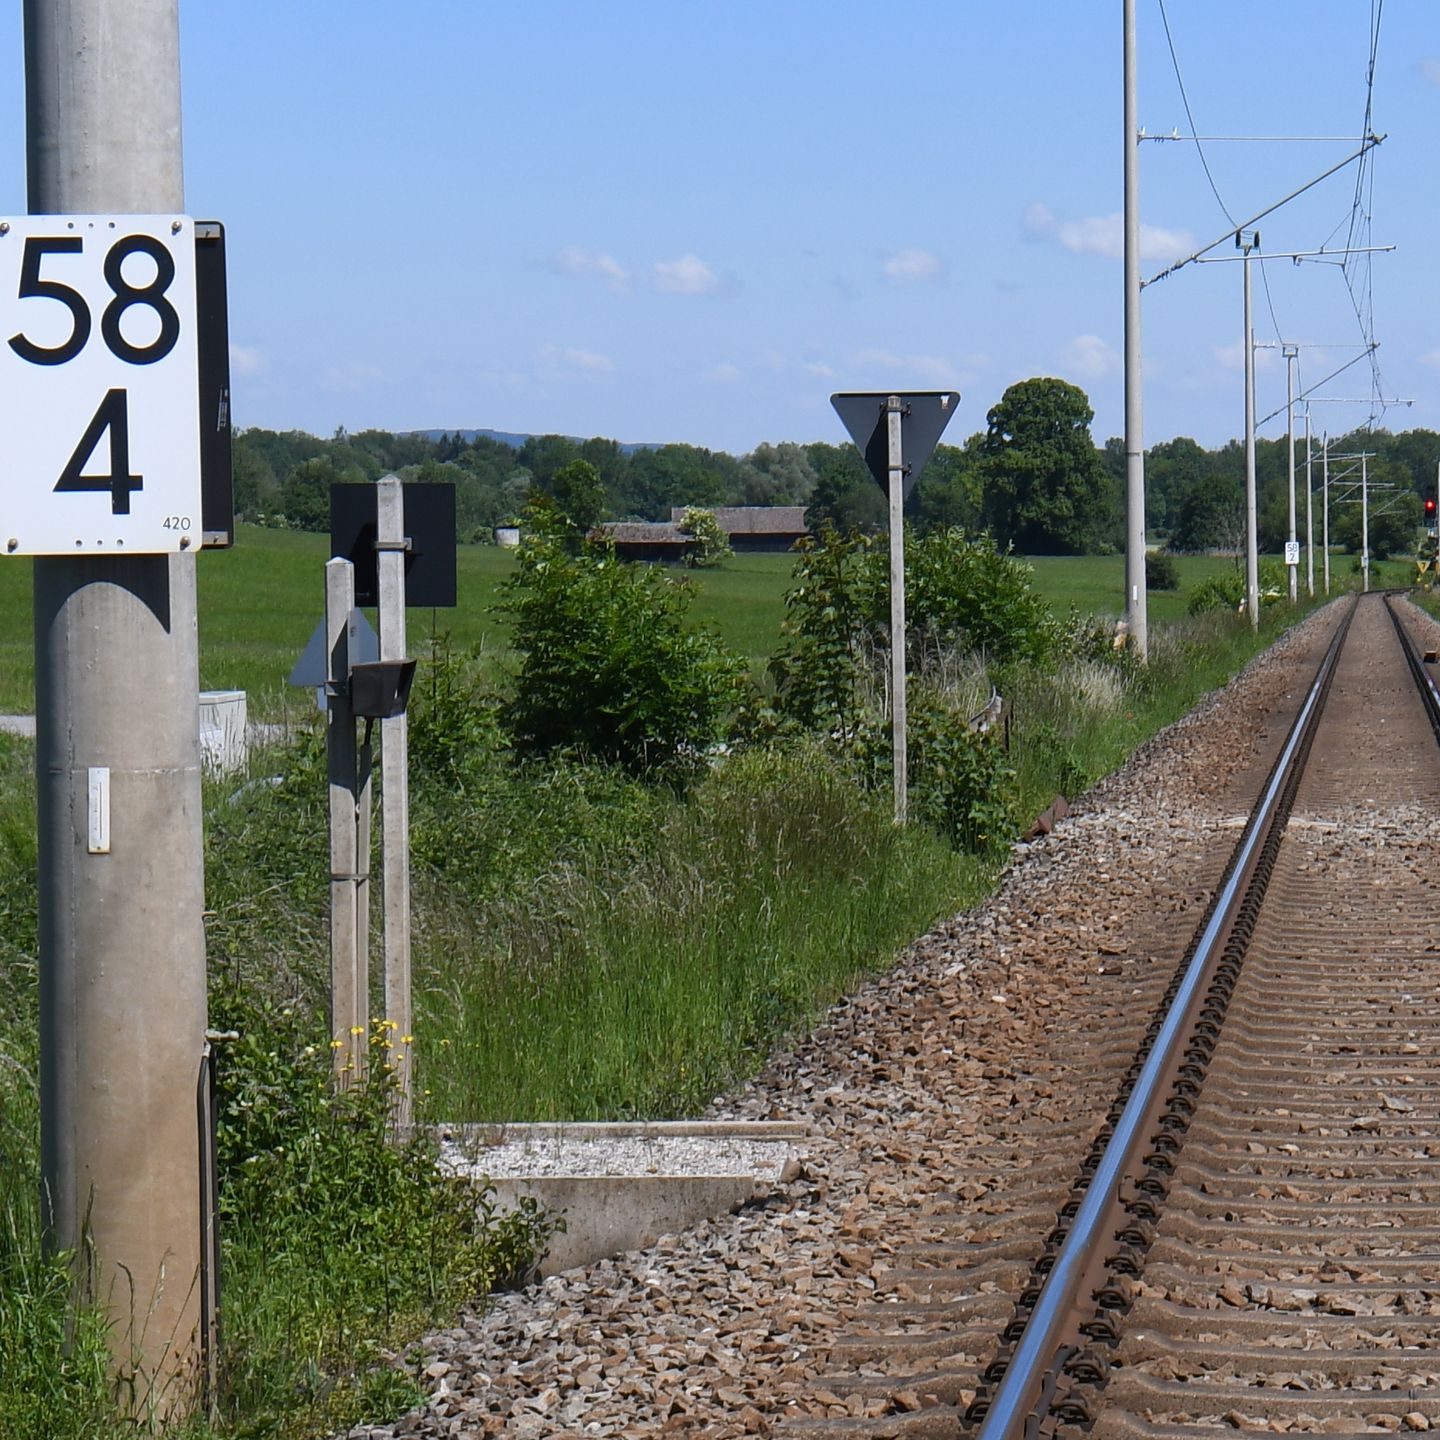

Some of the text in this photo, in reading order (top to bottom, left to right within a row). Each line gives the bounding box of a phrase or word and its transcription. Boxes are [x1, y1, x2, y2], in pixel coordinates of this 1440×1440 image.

[8, 233, 180, 365] 58
[52, 388, 143, 515] 4
[162, 516, 191, 531] 420
